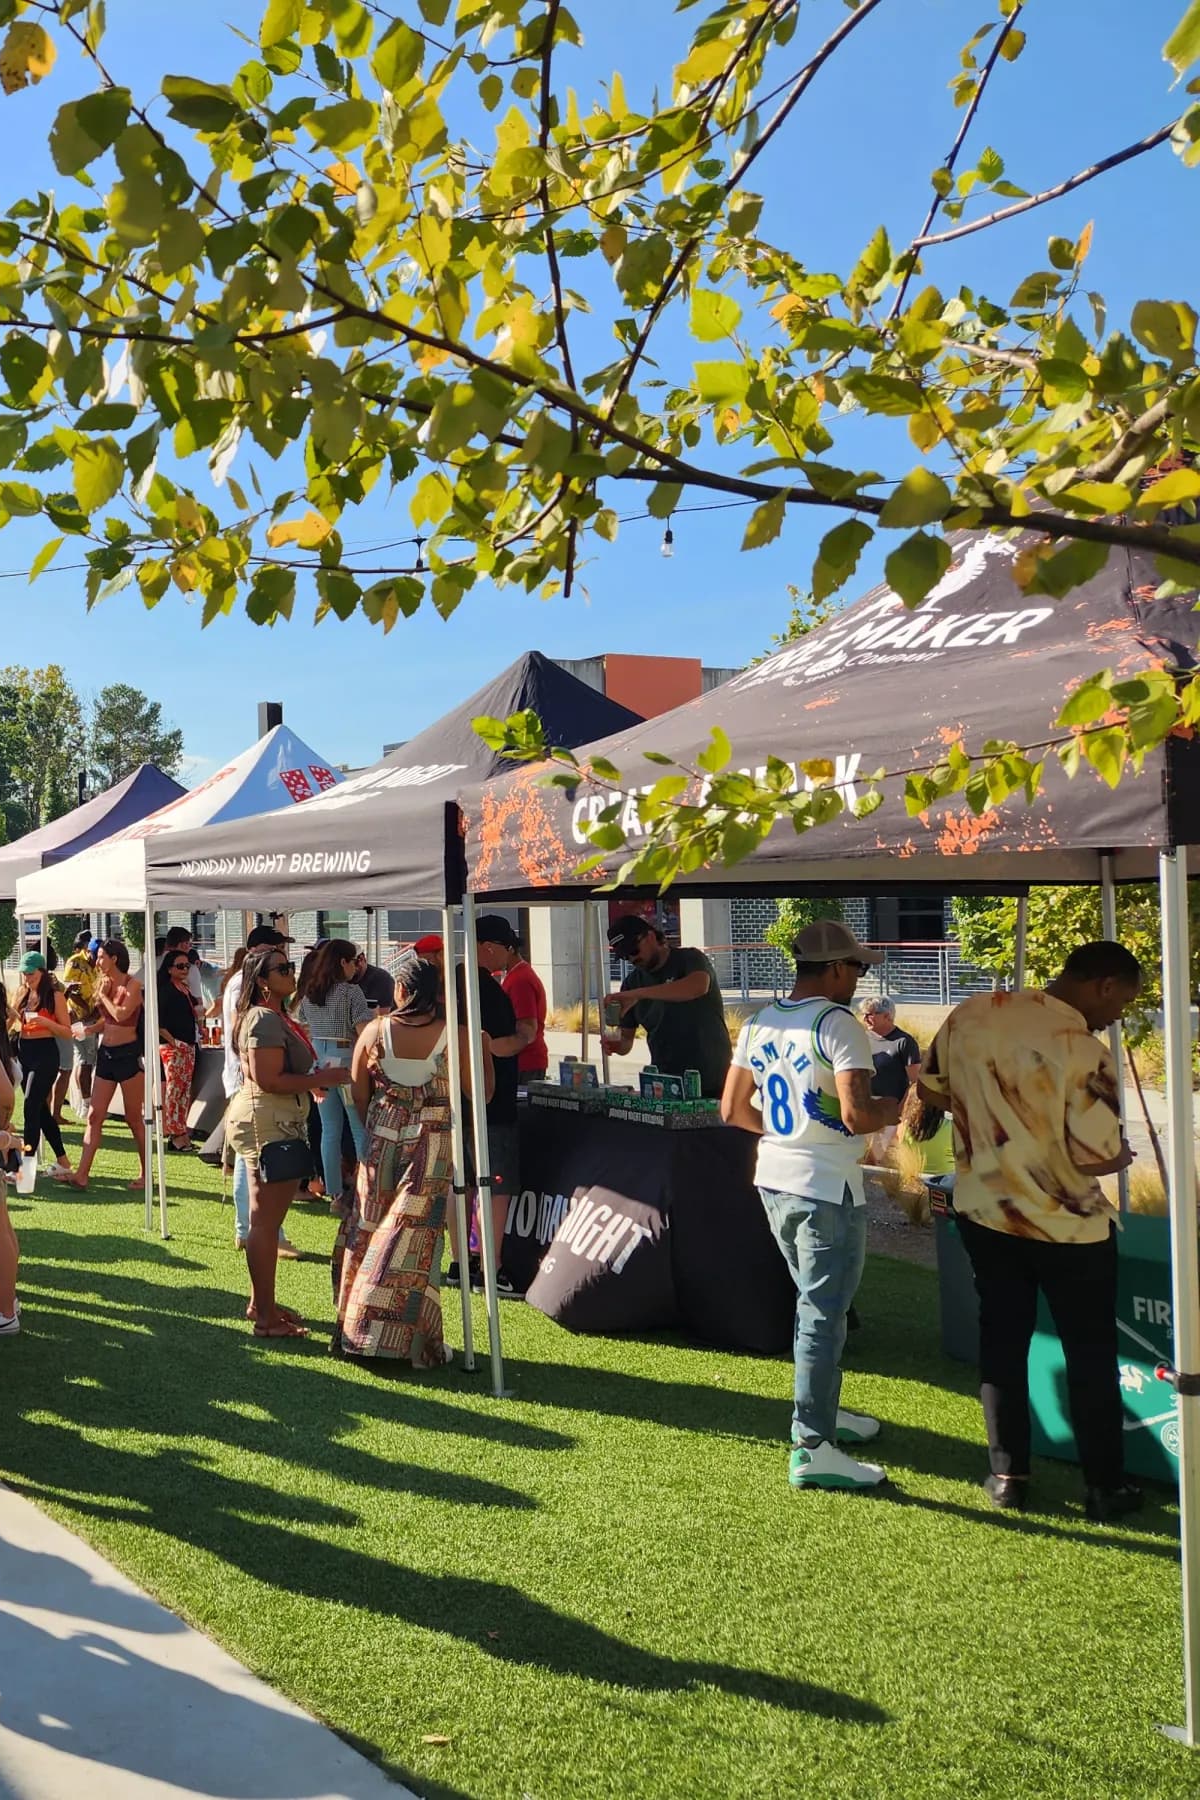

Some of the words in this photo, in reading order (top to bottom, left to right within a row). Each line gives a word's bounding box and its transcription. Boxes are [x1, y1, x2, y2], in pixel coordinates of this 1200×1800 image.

[829, 608, 1054, 651] MAKER
[178, 857, 236, 877] MONDAY
[238, 854, 286, 875] NIGHT
[289, 850, 371, 874] BREWING
[750, 1041, 812, 1074] SMTH
[767, 1073, 793, 1136] 8
[555, 1195, 652, 1274] NIGHT
